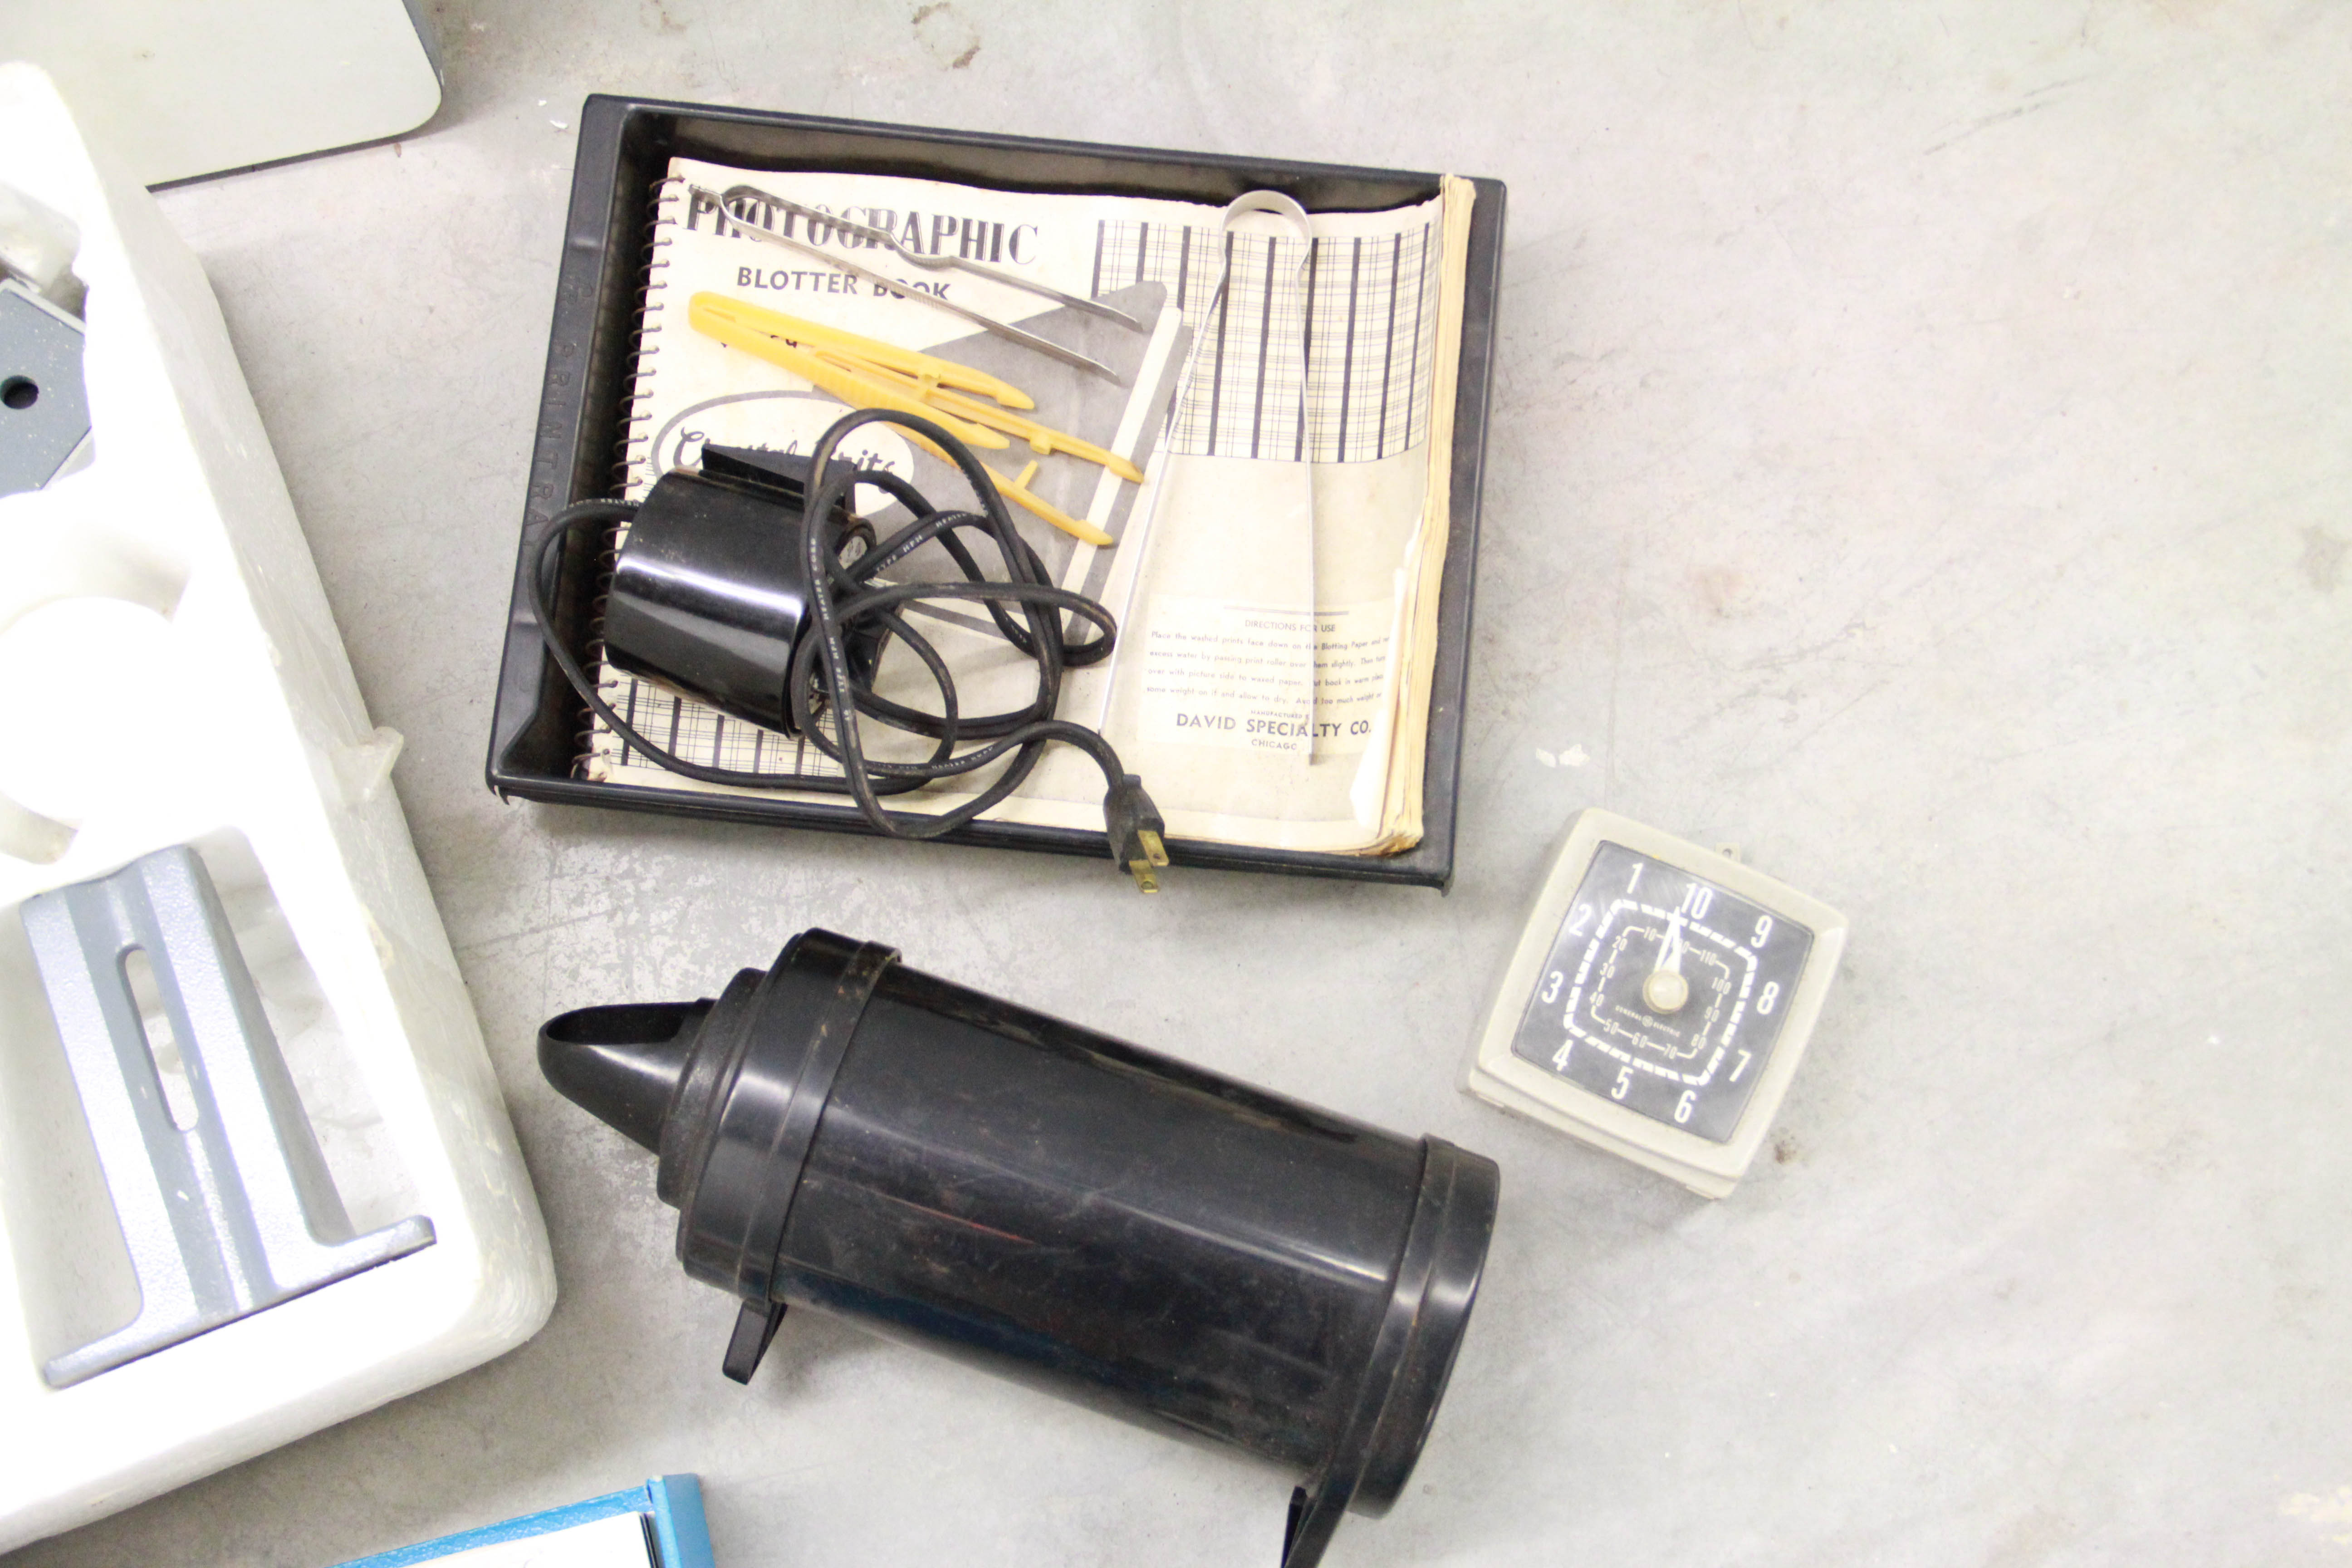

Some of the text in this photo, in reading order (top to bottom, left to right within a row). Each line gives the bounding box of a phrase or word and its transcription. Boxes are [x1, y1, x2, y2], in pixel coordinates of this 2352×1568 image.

[682, 192, 1038, 265] PHOTOGRAPHIC
[737, 266, 858, 295] BLOTTER
[1245, 620, 1296, 631] DIRECTIONS
[1321, 624, 1336, 632] USE
[1152, 631, 1171, 639] Place
[1191, 634, 1218, 642] washed
[1222, 636, 1244, 645] prints
[1248, 638, 1264, 646] face
[1268, 640, 1288, 648] down
[1321, 642, 1348, 651] Blotting
[1351, 641, 1368, 649] Paper
[1201, 652, 1210, 661] by
[1214, 655, 1242, 663] passing
[1267, 658, 1286, 666] roller
[1313, 660, 1328, 668] hem
[1170, 687, 1195, 696] weight
[1239, 691, 1258, 701] allow
[1337, 696, 1354, 704] much
[1356, 693, 1374, 702] weight
[1250, 710, 1303, 719] MANUFACTURED
[1176, 713, 1372, 737] DAVID SPECIALTY CO.
[1627, 862, 1644, 894] 1
[1680, 882, 1713, 921] 10
[1568, 903, 1592, 937] 2
[1643, 926, 1657, 942] 10
[1750, 915, 1773, 949] 9
[1612, 935, 1628, 951] 20
[1700, 949, 1718, 966] 110
[1599, 962, 1616, 979] 30
[1541, 970, 1564, 1004] 3
[1711, 976, 1732, 995] 100
[1590, 991, 1605, 1007] 40
[1756, 981, 1780, 1015] 8
[1704, 1006, 1720, 1023] 90
[1603, 1018, 1619, 1035] 50
[1632, 1032, 1648, 1049] 60
[1690, 1033, 1707, 1050] 80
[1552, 1039, 1573, 1072] 4
[1663, 1043, 1678, 1060] 70
[1728, 1049, 1752, 1083] 7
[1610, 1067, 1635, 1101] 5
[1674, 1090, 1697, 1124] 6
